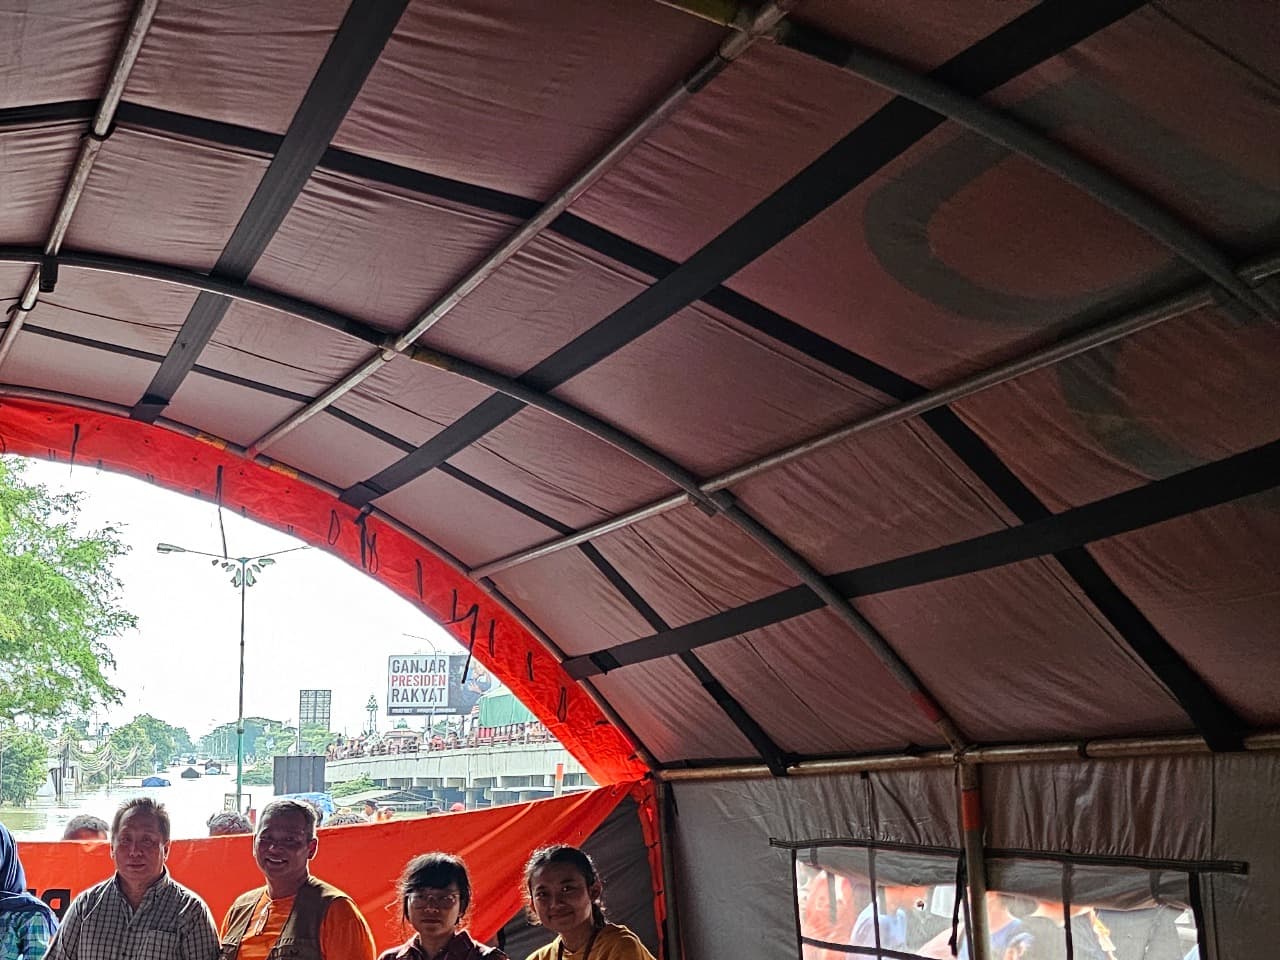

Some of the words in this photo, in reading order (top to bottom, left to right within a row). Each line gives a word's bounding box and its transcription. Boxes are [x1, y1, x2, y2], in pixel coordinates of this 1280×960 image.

[392, 659, 446, 674] GANJAR
[391, 674, 446, 687] PRESIDEN
[391, 687, 446, 703] RAKYAT
